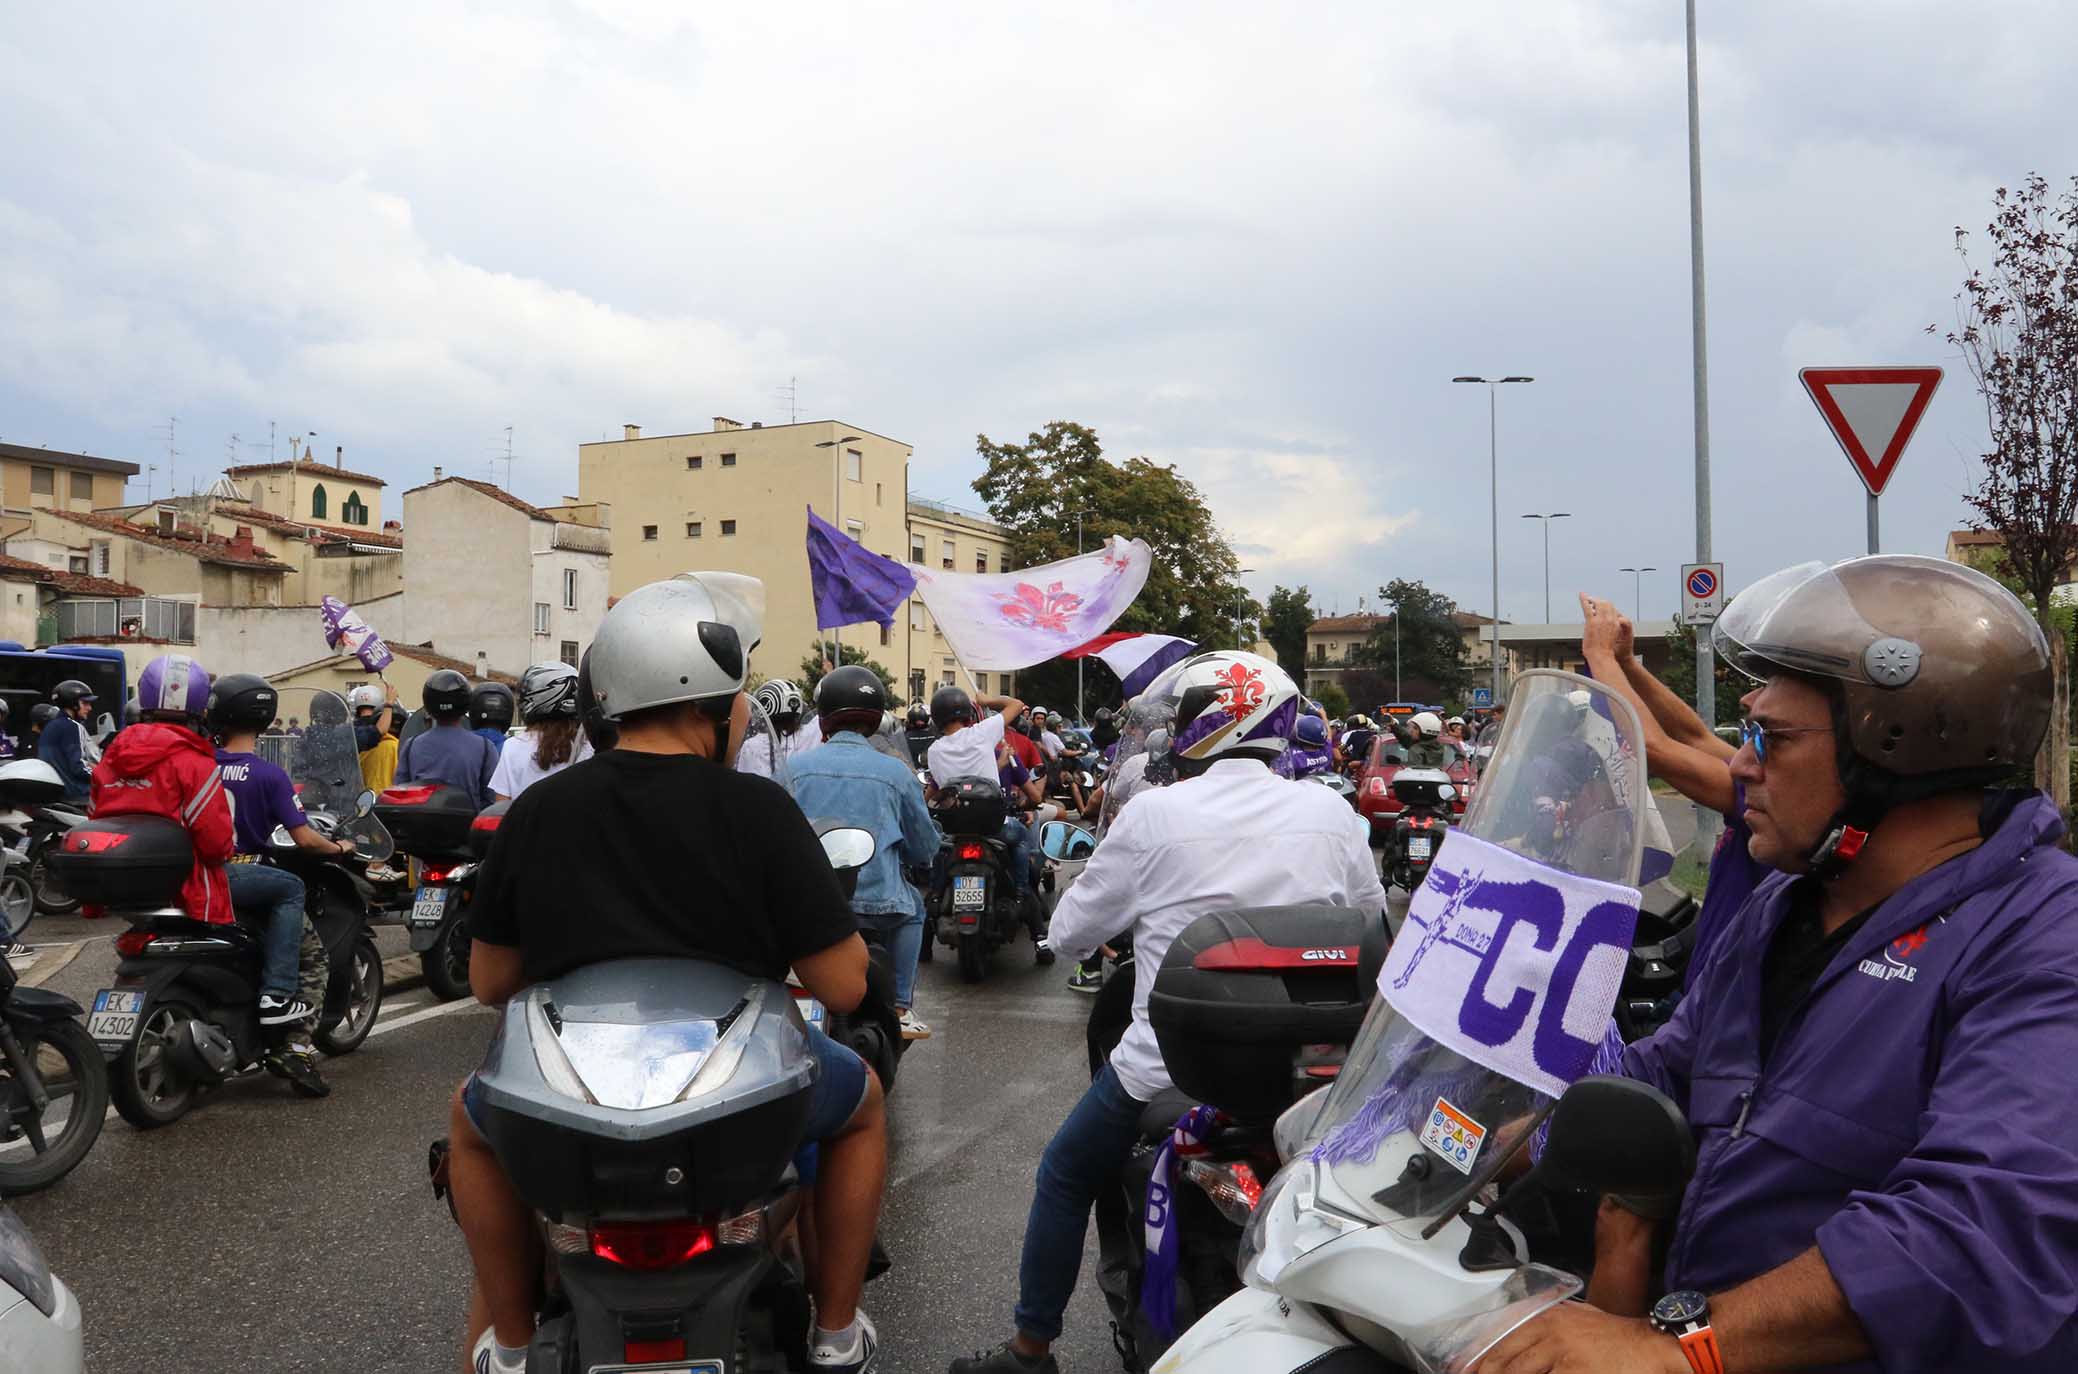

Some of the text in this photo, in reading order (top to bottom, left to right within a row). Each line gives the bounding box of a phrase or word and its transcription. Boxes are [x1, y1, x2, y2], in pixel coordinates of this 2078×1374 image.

[423, 888, 436, 901] EK
[955, 890, 983, 903] 32655
[1301, 949, 1347, 960] GIVI
[106, 992, 128, 1011] EK
[92, 1016, 135, 1036] 14302
